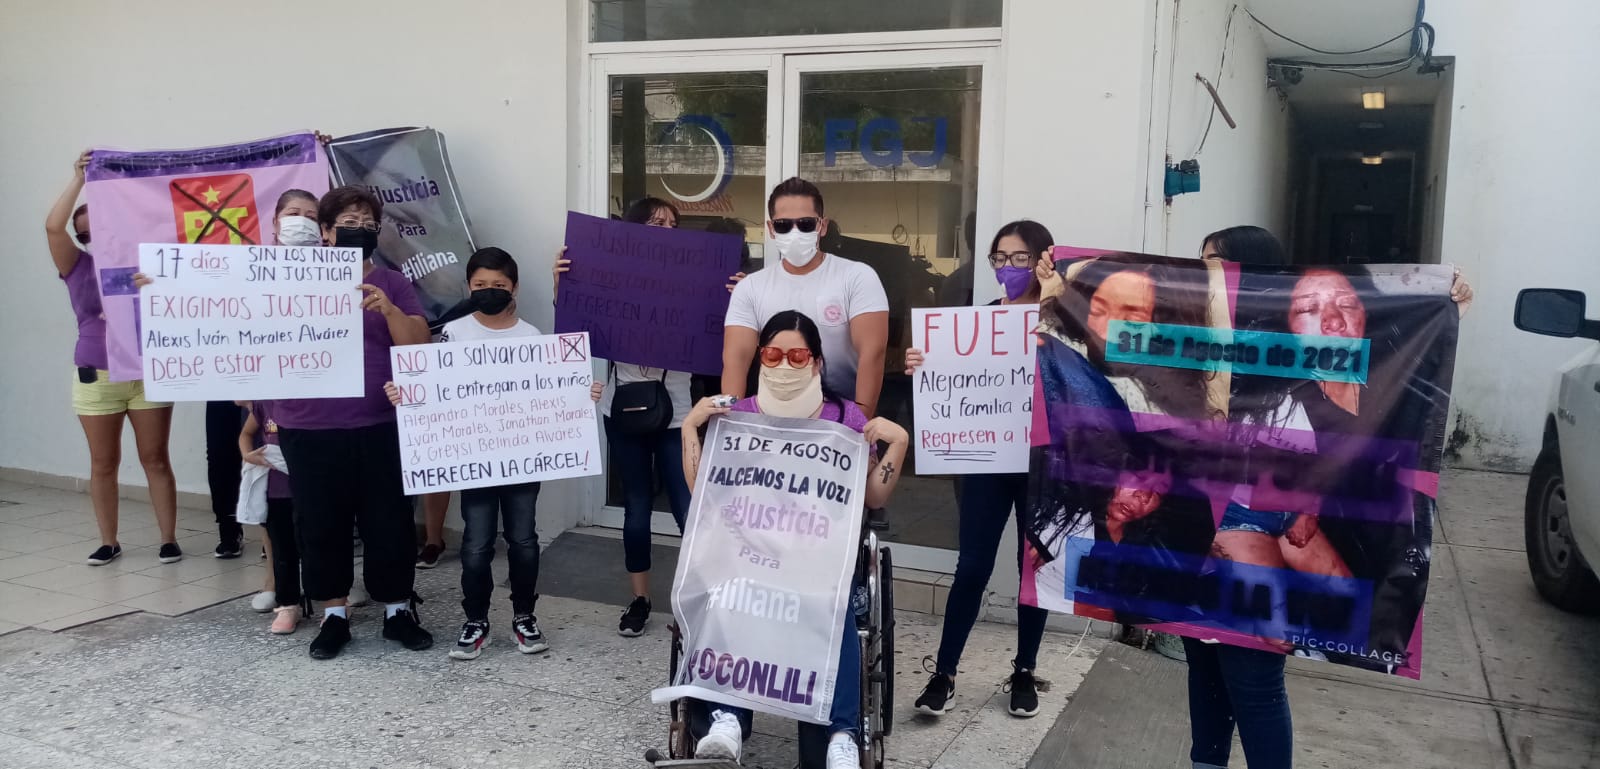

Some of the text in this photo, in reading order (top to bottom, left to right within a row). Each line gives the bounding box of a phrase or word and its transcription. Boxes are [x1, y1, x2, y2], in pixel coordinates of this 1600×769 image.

[824, 117, 948, 168] FGJ
[183, 207, 249, 245] PT
[396, 223, 427, 239] Para
[156, 248, 231, 279] 17 días
[248, 246, 277, 262] SIN
[284, 248, 306, 262] LOS
[401, 251, 459, 282] #liliana
[246, 264, 353, 281] SIN JUSTICIA
[149, 293, 352, 320] EXIGIMOS JUSTICIA
[147, 330, 191, 349] Alexis
[197, 328, 230, 346] Iván
[239, 330, 293, 346] Morales
[1118, 331, 1362, 373] 31 de Agosto de 2021
[214, 350, 266, 375] estar
[279, 350, 333, 378] preso
[397, 350, 428, 372] NO
[438, 349, 453, 369] la
[399, 371, 591, 405] NO le entregan a los niños
[920, 368, 1005, 401] Alejandro
[404, 406, 468, 432] Alejandro
[530, 396, 567, 411] Alexis
[498, 417, 550, 433] Jonathan
[555, 407, 595, 423] Morales
[930, 402, 951, 420] su
[959, 396, 1012, 417] familia
[479, 433, 529, 452] Belinda
[535, 427, 583, 444] Alvares
[724, 436, 852, 471] 31 DE AGOSTO
[921, 429, 996, 455] Regresen
[1004, 430, 1014, 442] a
[404, 450, 590, 489] ¡MERECEN LA CÁRCEL!
[788, 474, 810, 495] LA
[721, 496, 832, 540] #Justicia
[739, 545, 781, 569] Para
[706, 577, 801, 623] #liliana
